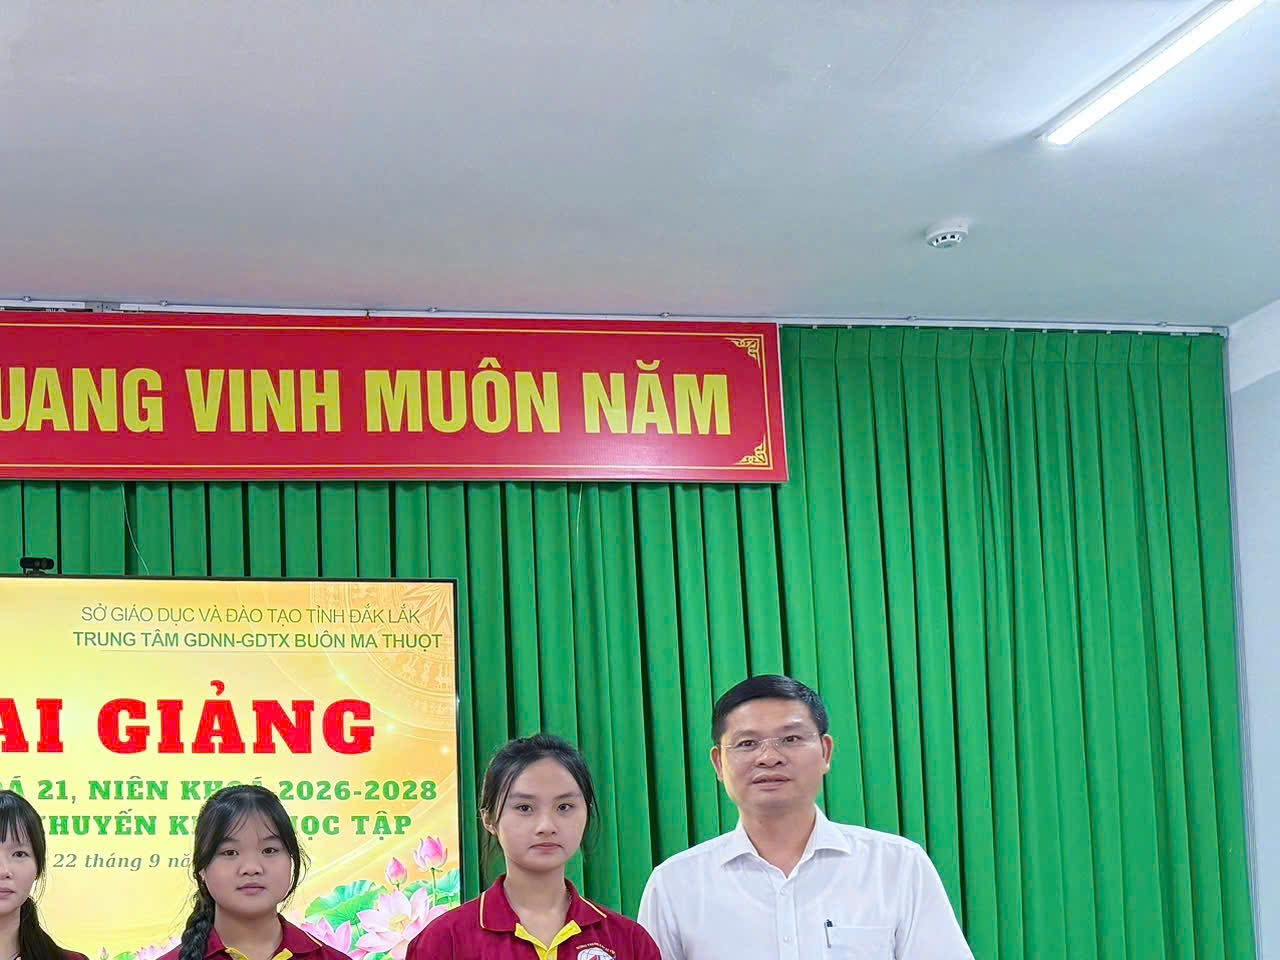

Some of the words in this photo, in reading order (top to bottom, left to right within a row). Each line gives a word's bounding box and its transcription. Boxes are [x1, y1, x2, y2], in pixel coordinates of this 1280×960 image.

[185, 369, 342, 433] VINH
[367, 357, 560, 434] MUÔN
[582, 358, 732, 435] NĂM
[81, 603, 108, 622] SỞ
[110, 605, 153, 622] GIÁO
[158, 608, 195, 627] DỤC
[199, 605, 223, 622] VÀ
[226, 605, 263, 623] ĐÀO
[267, 608, 302, 627] TẠO
[305, 605, 345, 624] TỈNH
[349, 604, 385, 624] ĐẮK
[388, 604, 420, 624] LẮK
[73, 631, 136, 647] TRUNG
[140, 629, 179, 647] TÂM
[184, 632, 290, 648] GDNN-GDTX
[295, 630, 346, 649] BUÔN
[351, 634, 378, 649] MA
[97, 679, 375, 754] GIẢNG
[38, 780, 76, 804] 21,
[89, 775, 168, 800] NIÊN
[278, 780, 438, 800] 2026-2028
[42, 809, 157, 835] HUYẾN
[352, 810, 412, 840] TẬP
[53, 853, 77, 868] 22
[85, 853, 142, 871] tháng
[149, 853, 160, 868] 9
[168, 853, 191, 868] nă
